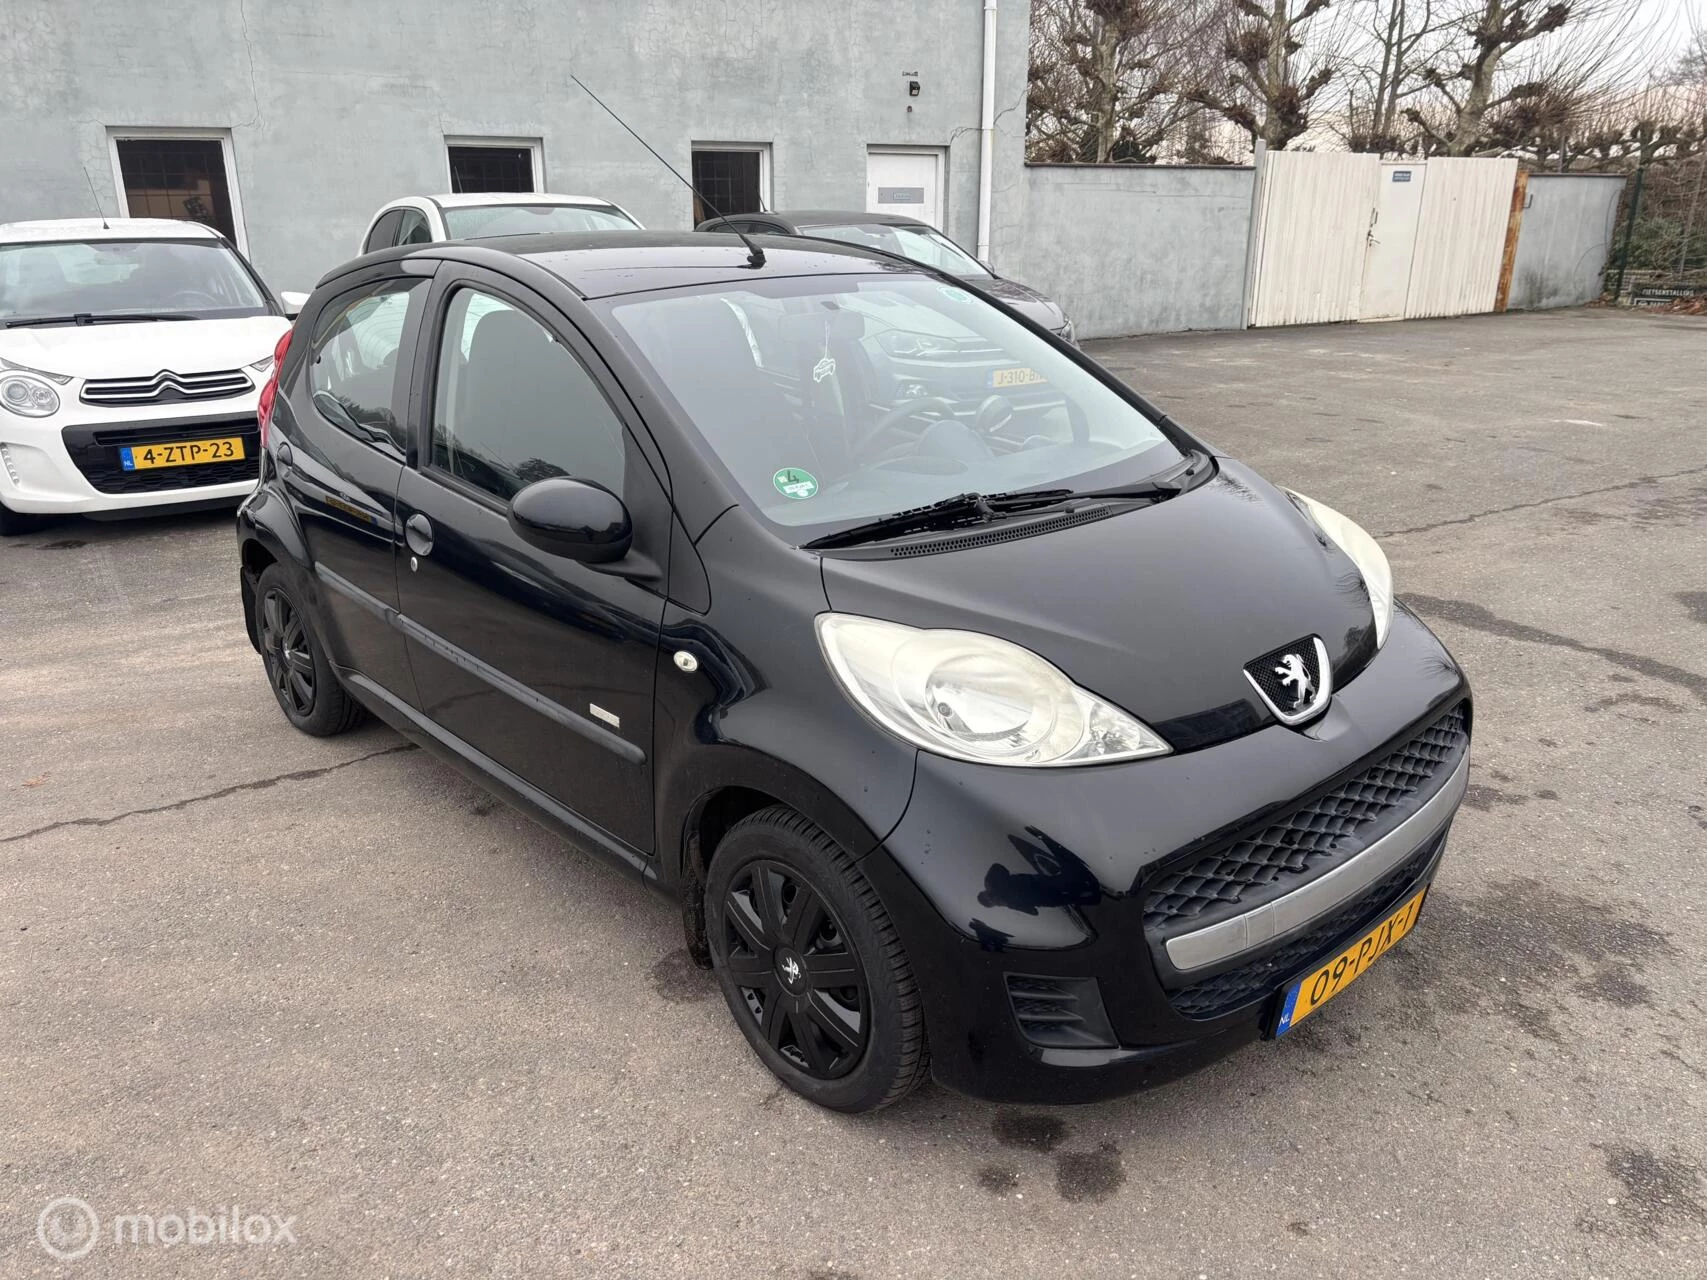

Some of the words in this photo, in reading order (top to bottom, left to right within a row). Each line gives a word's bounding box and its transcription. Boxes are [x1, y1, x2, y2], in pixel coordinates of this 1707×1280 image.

[143, 441, 234, 465] 4-ZTP-23
[1310, 900, 1415, 1006] 09-PJX-1
[1279, 1013, 1290, 1026] NL
